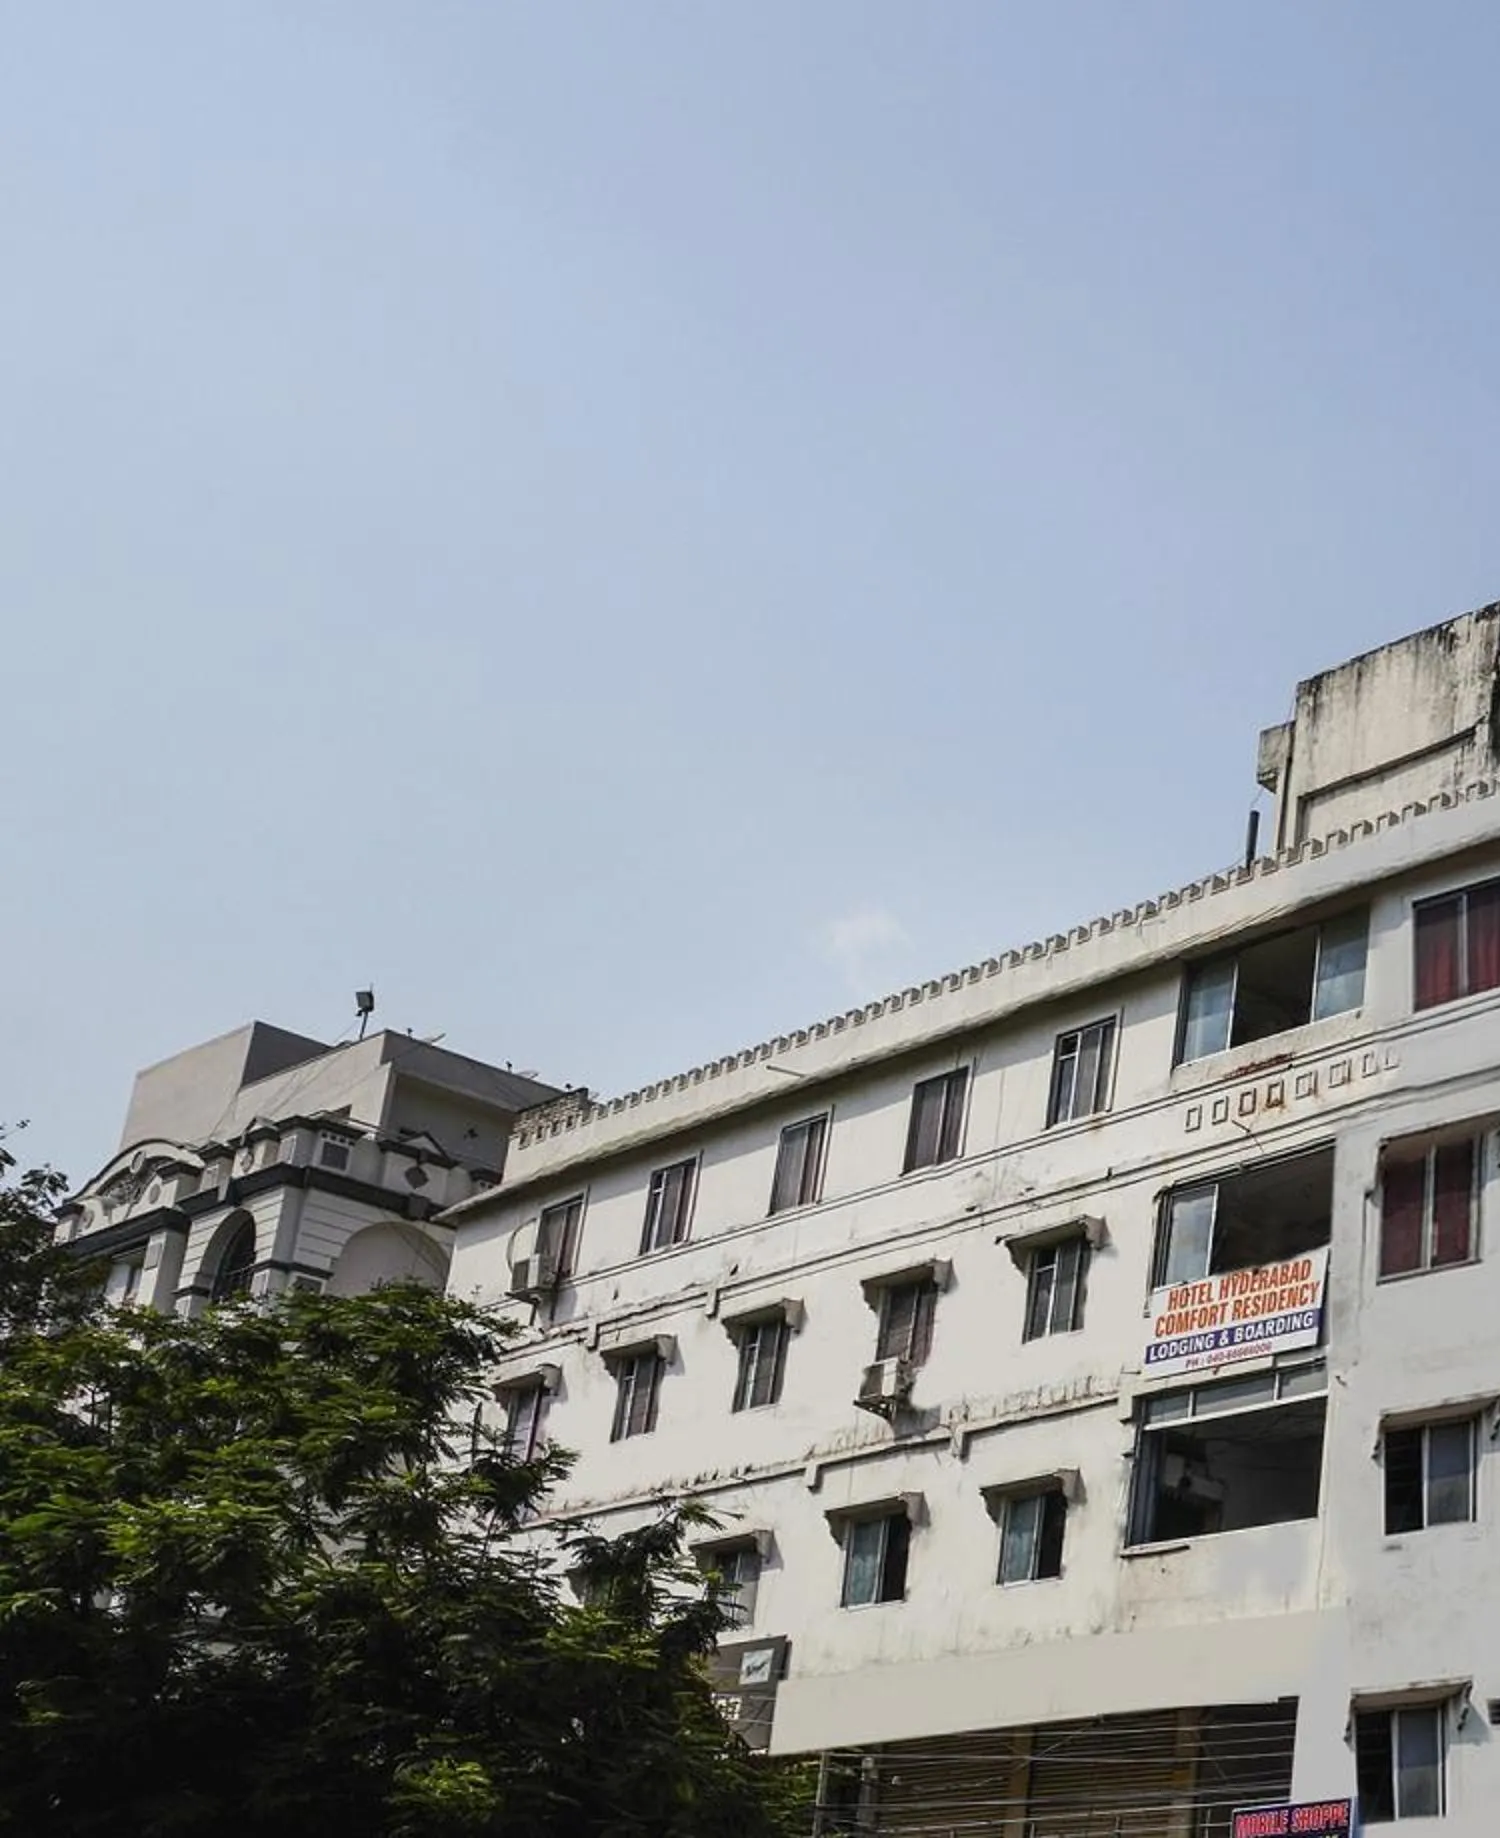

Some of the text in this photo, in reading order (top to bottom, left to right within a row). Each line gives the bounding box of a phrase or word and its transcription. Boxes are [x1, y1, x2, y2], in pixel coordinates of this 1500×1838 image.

[1155, 1281, 1321, 1338] COMFORT RESIDENCY
[1167, 1259, 1313, 1311] HOTEL HYDERABAD
[1150, 1312, 1314, 1361] LODGING & BOARDING
[1235, 1802, 1349, 1838] MOBILE SHOPPE
